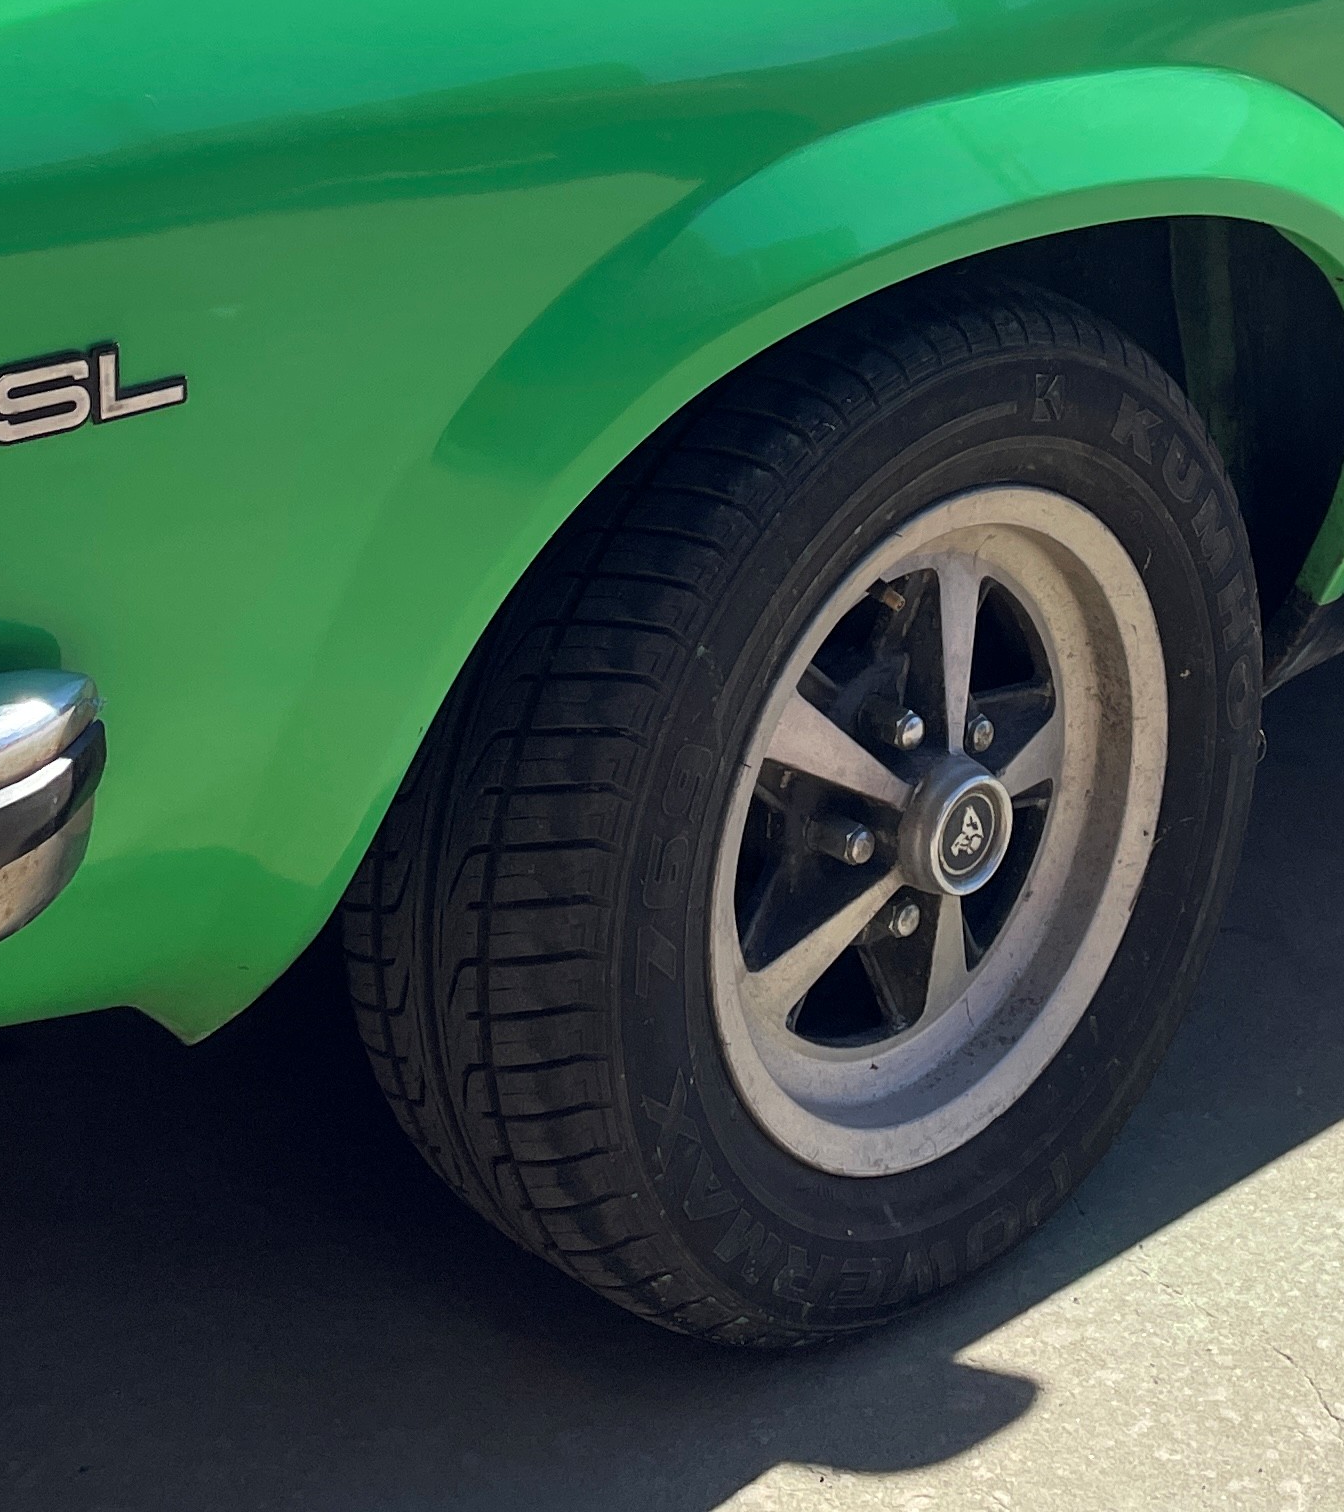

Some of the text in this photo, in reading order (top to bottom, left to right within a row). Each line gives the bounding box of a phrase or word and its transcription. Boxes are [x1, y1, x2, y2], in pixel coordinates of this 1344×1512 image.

[1110, 392, 1256, 731] KUMHO
[635, 743, 714, 999] 769
[640, 1066, 1073, 1310] POWERMAX
